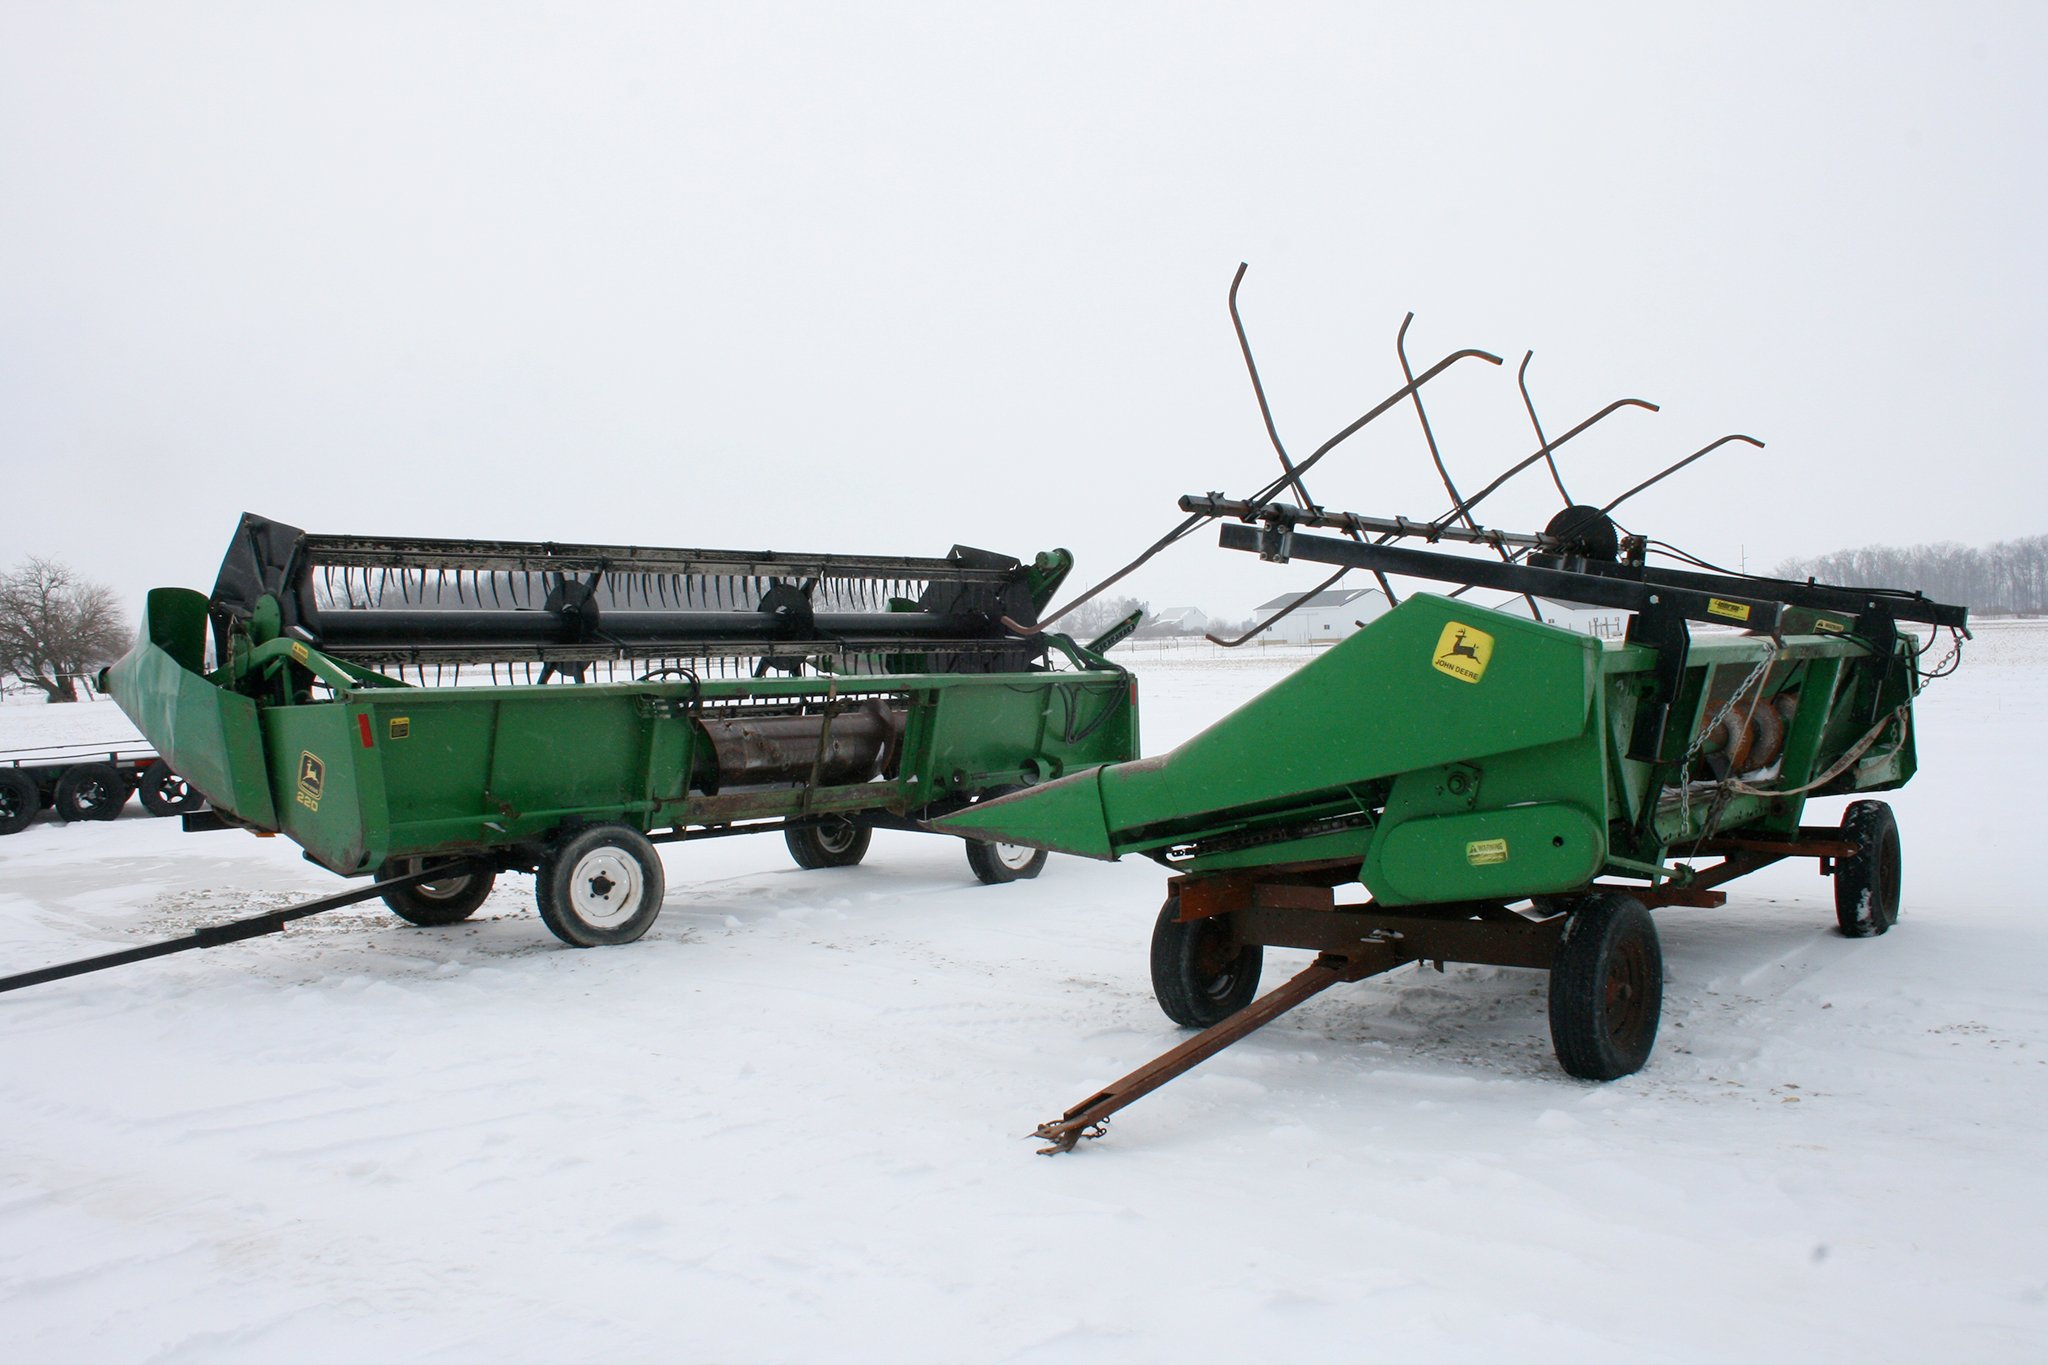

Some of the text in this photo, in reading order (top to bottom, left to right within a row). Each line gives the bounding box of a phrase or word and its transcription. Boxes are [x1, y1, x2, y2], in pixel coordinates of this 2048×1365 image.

[1435, 659, 1479, 680] JOHN DEERE
[296, 791, 319, 812] 220
